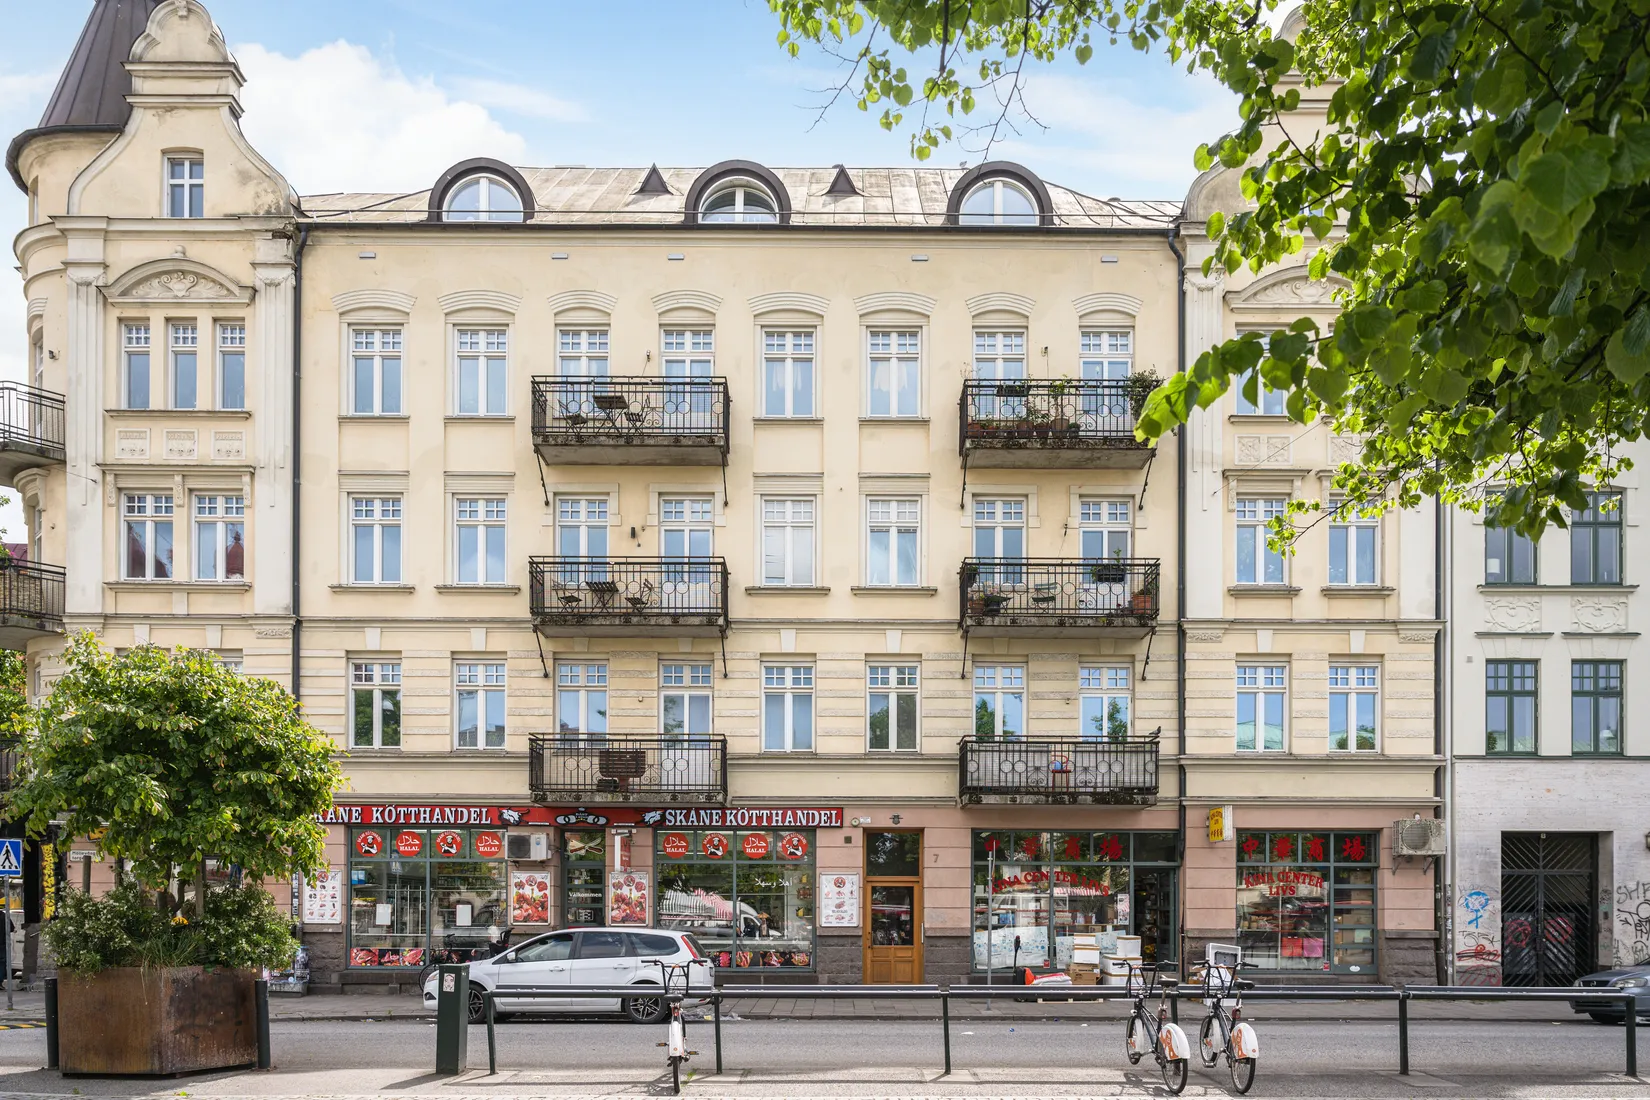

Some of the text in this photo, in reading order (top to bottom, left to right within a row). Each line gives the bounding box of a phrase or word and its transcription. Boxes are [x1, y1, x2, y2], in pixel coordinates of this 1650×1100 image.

[313, 804, 491, 824] KÅNE KÖTTHANDEL
[665, 806, 841, 827] SKÅNE KÖTTHANDEL
[397, 835, 420, 846] حلال
[477, 835, 500, 846] حلال
[664, 836, 687, 847] حلال
[744, 836, 767, 848] حلال
[933, 853, 940, 864] 7
[987, 874, 1022, 895] KINA
[1024, 870, 1079, 885] CENTER
[1243, 871, 1325, 889] KINA CENTER
[1268, 885, 1296, 896] LIVS
